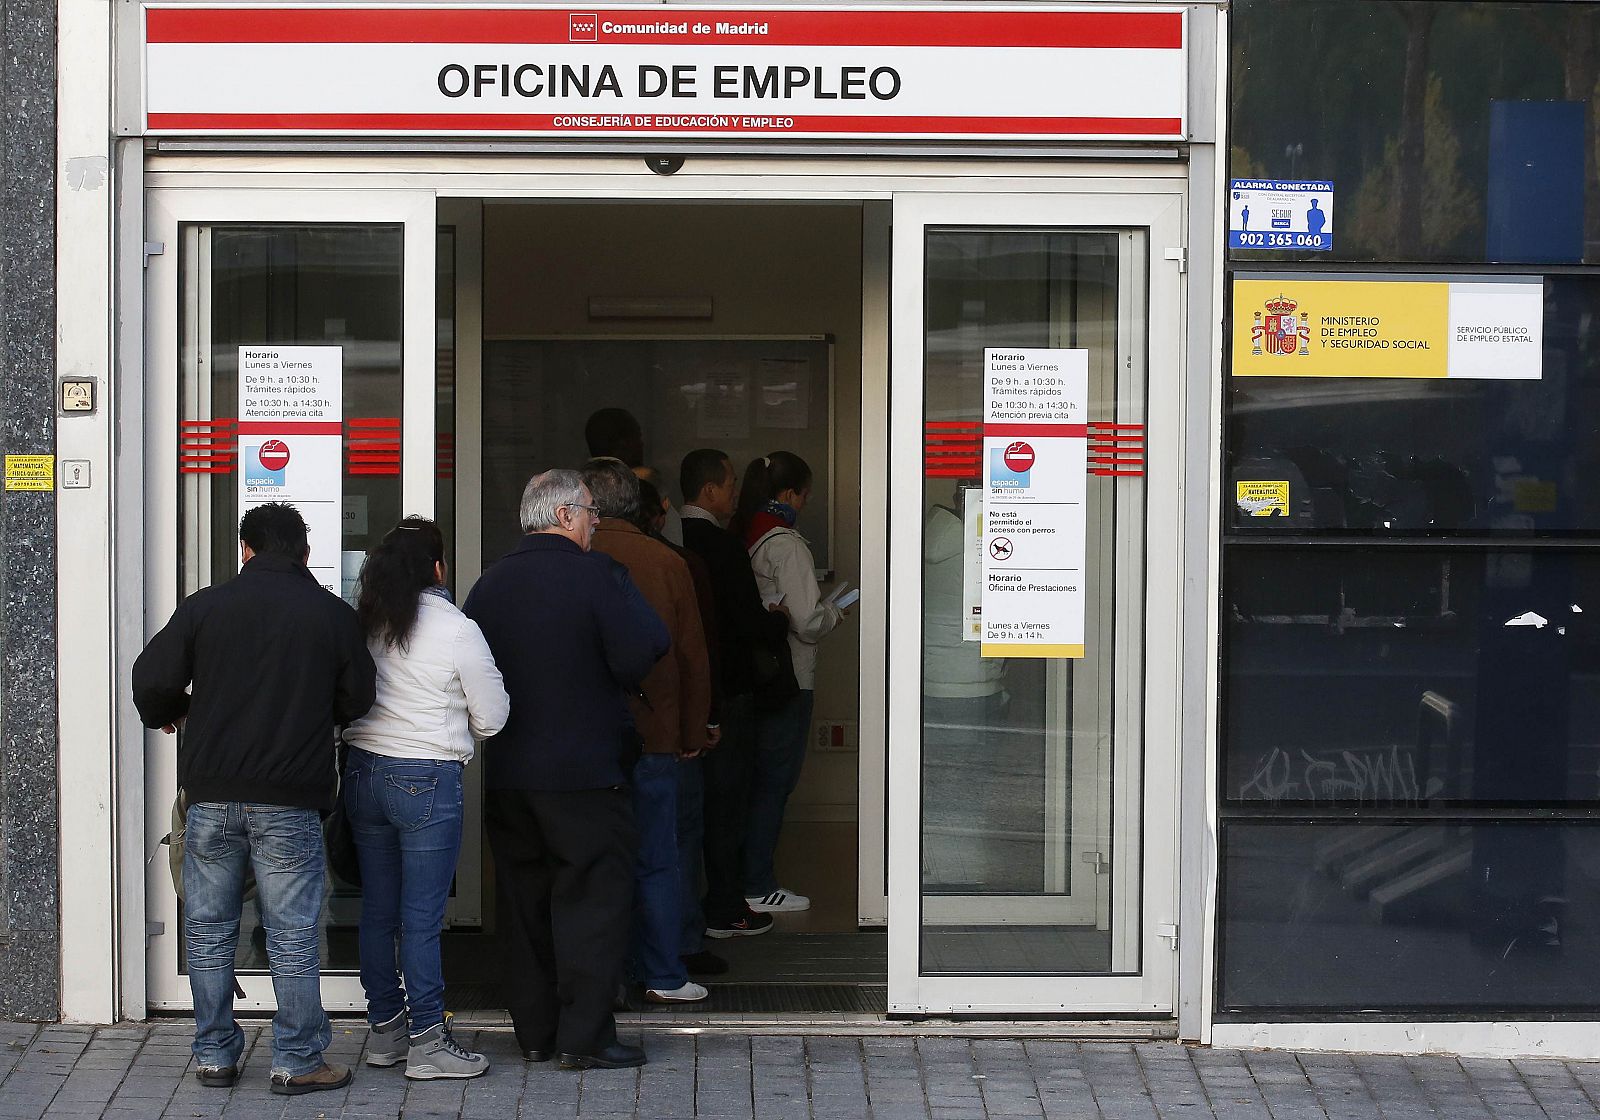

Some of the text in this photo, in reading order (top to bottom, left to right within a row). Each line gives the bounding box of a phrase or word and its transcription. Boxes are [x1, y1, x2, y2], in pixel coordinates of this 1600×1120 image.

[601, 21, 768, 35] Comunidad de Madrid
[438, 64, 901, 100] OFICINA DE EMPLEO
[553, 114, 794, 128] CONSEJERÍA DE EDUCACIÓN Y EMPLEO
[1271, 209, 1291, 218] SEGUR
[1240, 233, 1321, 246] 902 365 060
[1322, 317, 1379, 325] MINISTERIO
[1322, 328, 1377, 337] DE EMPLEO
[1331, 340, 1389, 348] SEGURIDAD
[1393, 341, 1430, 349] SOCIAL
[245, 361, 271, 369] Lunes
[284, 386, 316, 394] rápidos
[992, 387, 1061, 396] Trámites rápidos
[283, 409, 306, 418] previa
[247, 477, 274, 485] espacio
[992, 479, 1018, 487] espacio
